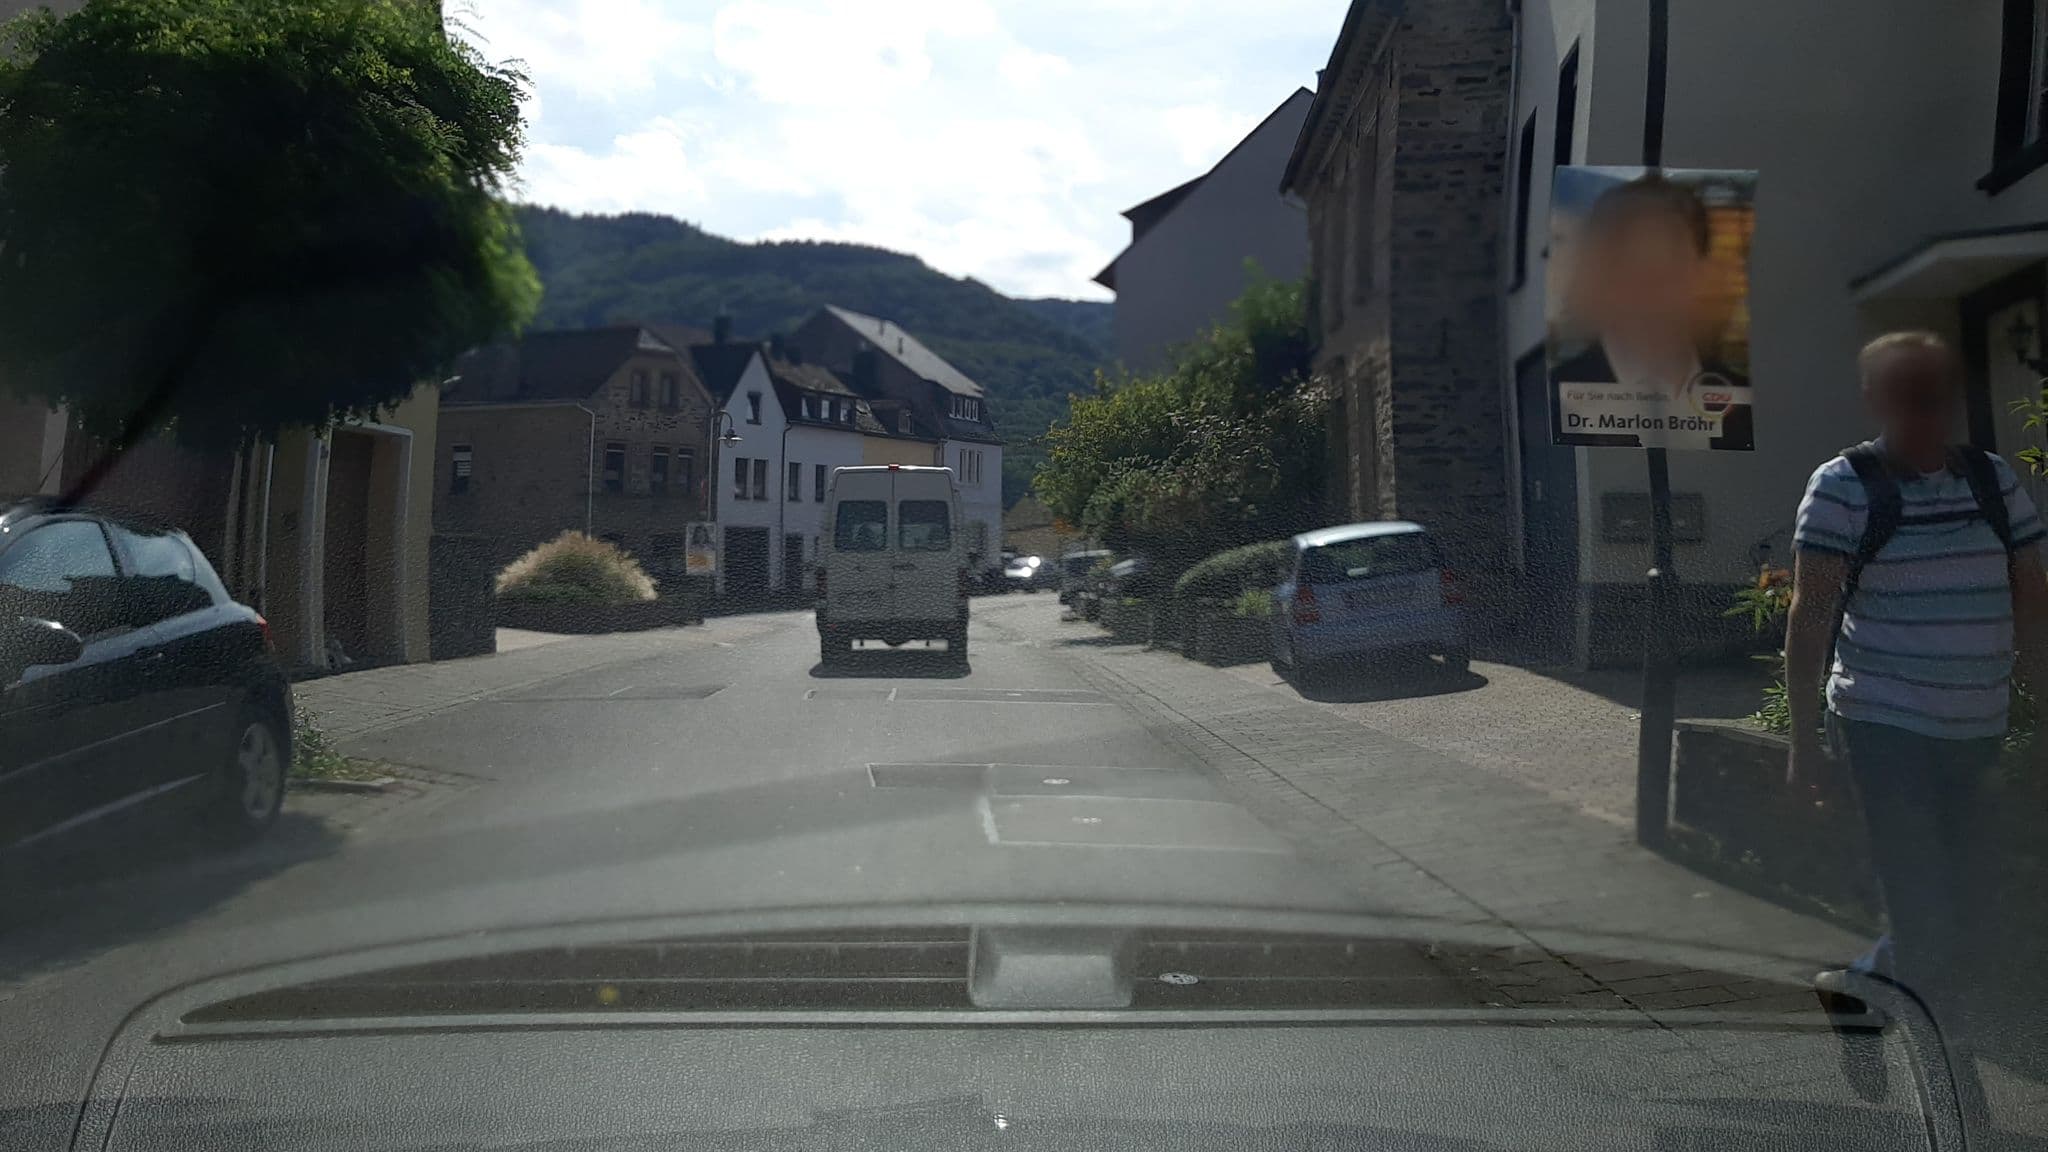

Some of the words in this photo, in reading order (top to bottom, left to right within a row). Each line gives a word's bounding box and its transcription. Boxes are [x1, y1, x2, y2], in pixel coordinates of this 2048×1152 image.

[1702, 391, 1733, 401] CDU
[1567, 413, 1593, 429] Dr.
[1598, 414, 1664, 430] Marlon
[1669, 414, 1715, 431] Bröhr
